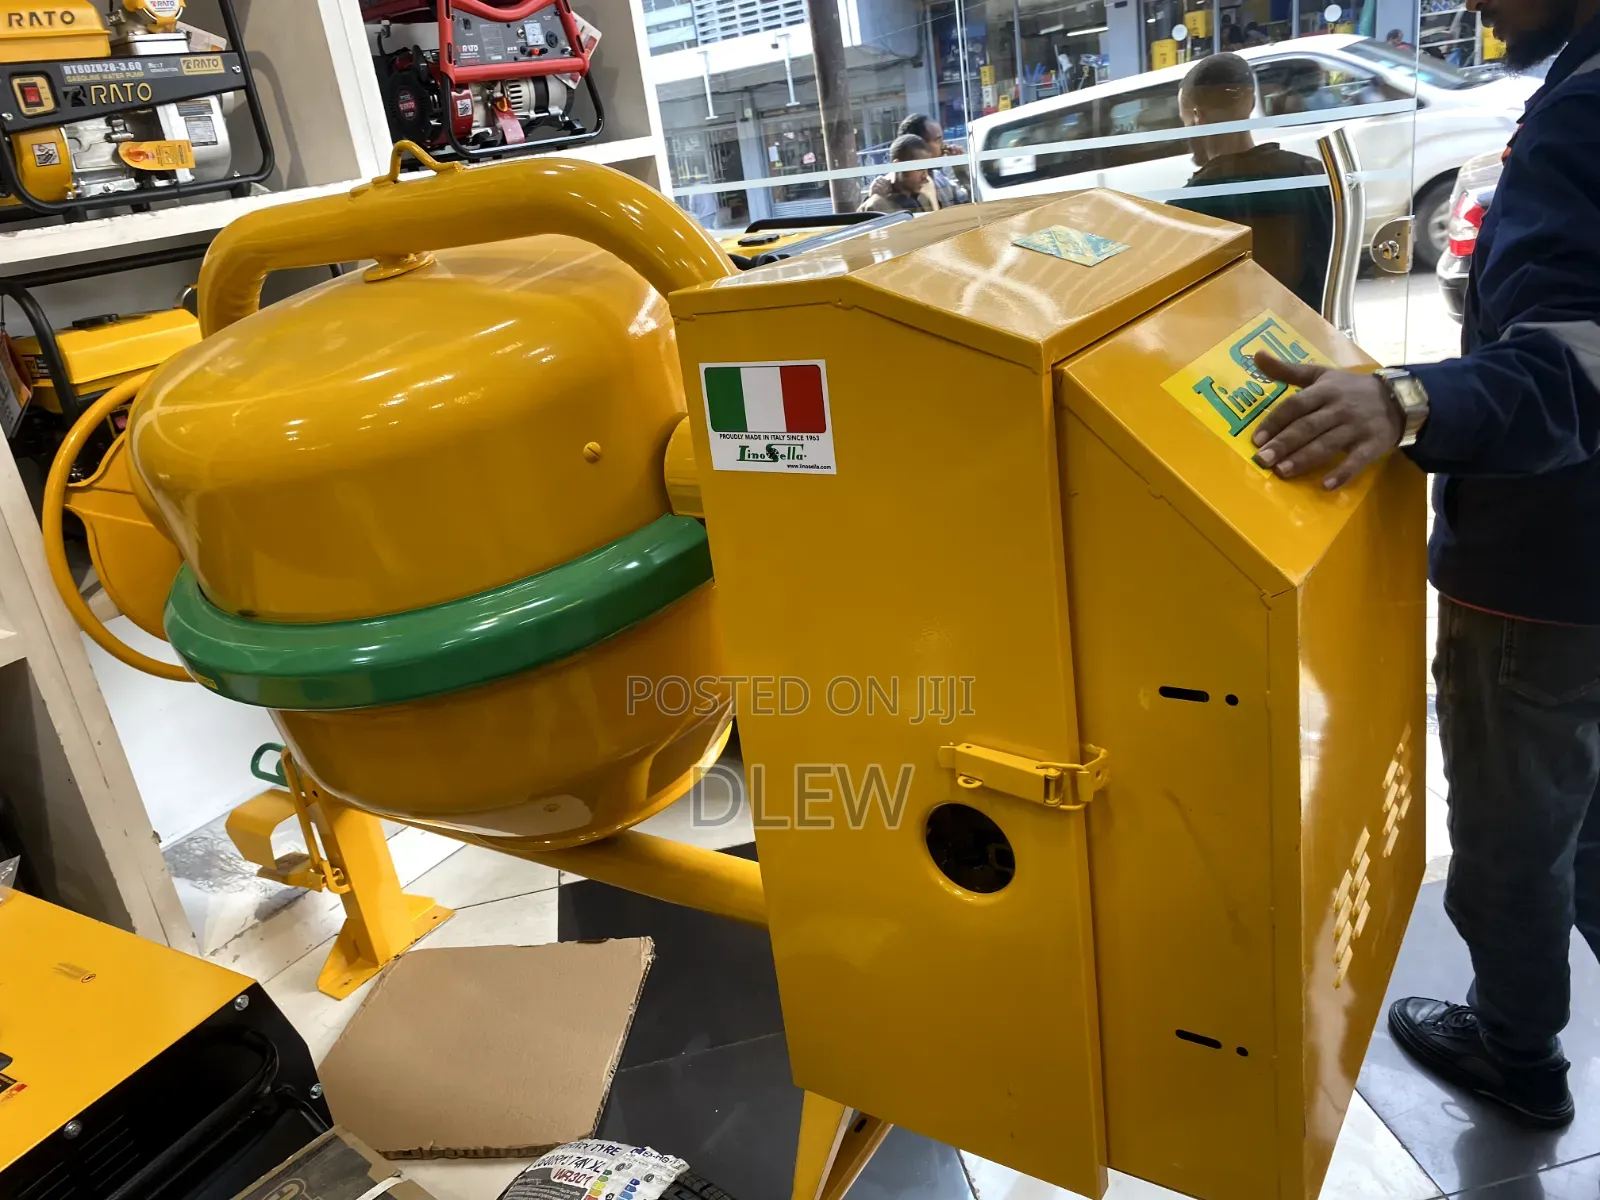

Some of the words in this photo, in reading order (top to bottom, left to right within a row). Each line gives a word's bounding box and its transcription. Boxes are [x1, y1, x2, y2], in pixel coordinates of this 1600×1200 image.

[7, 10, 75, 27] RATO
[193, 58, 219, 69] RATO
[101, 72, 125, 80] WATER
[125, 71, 145, 79] PUMP
[90, 82, 152, 105] RATO
[590, 1143, 623, 1156] TYRE
